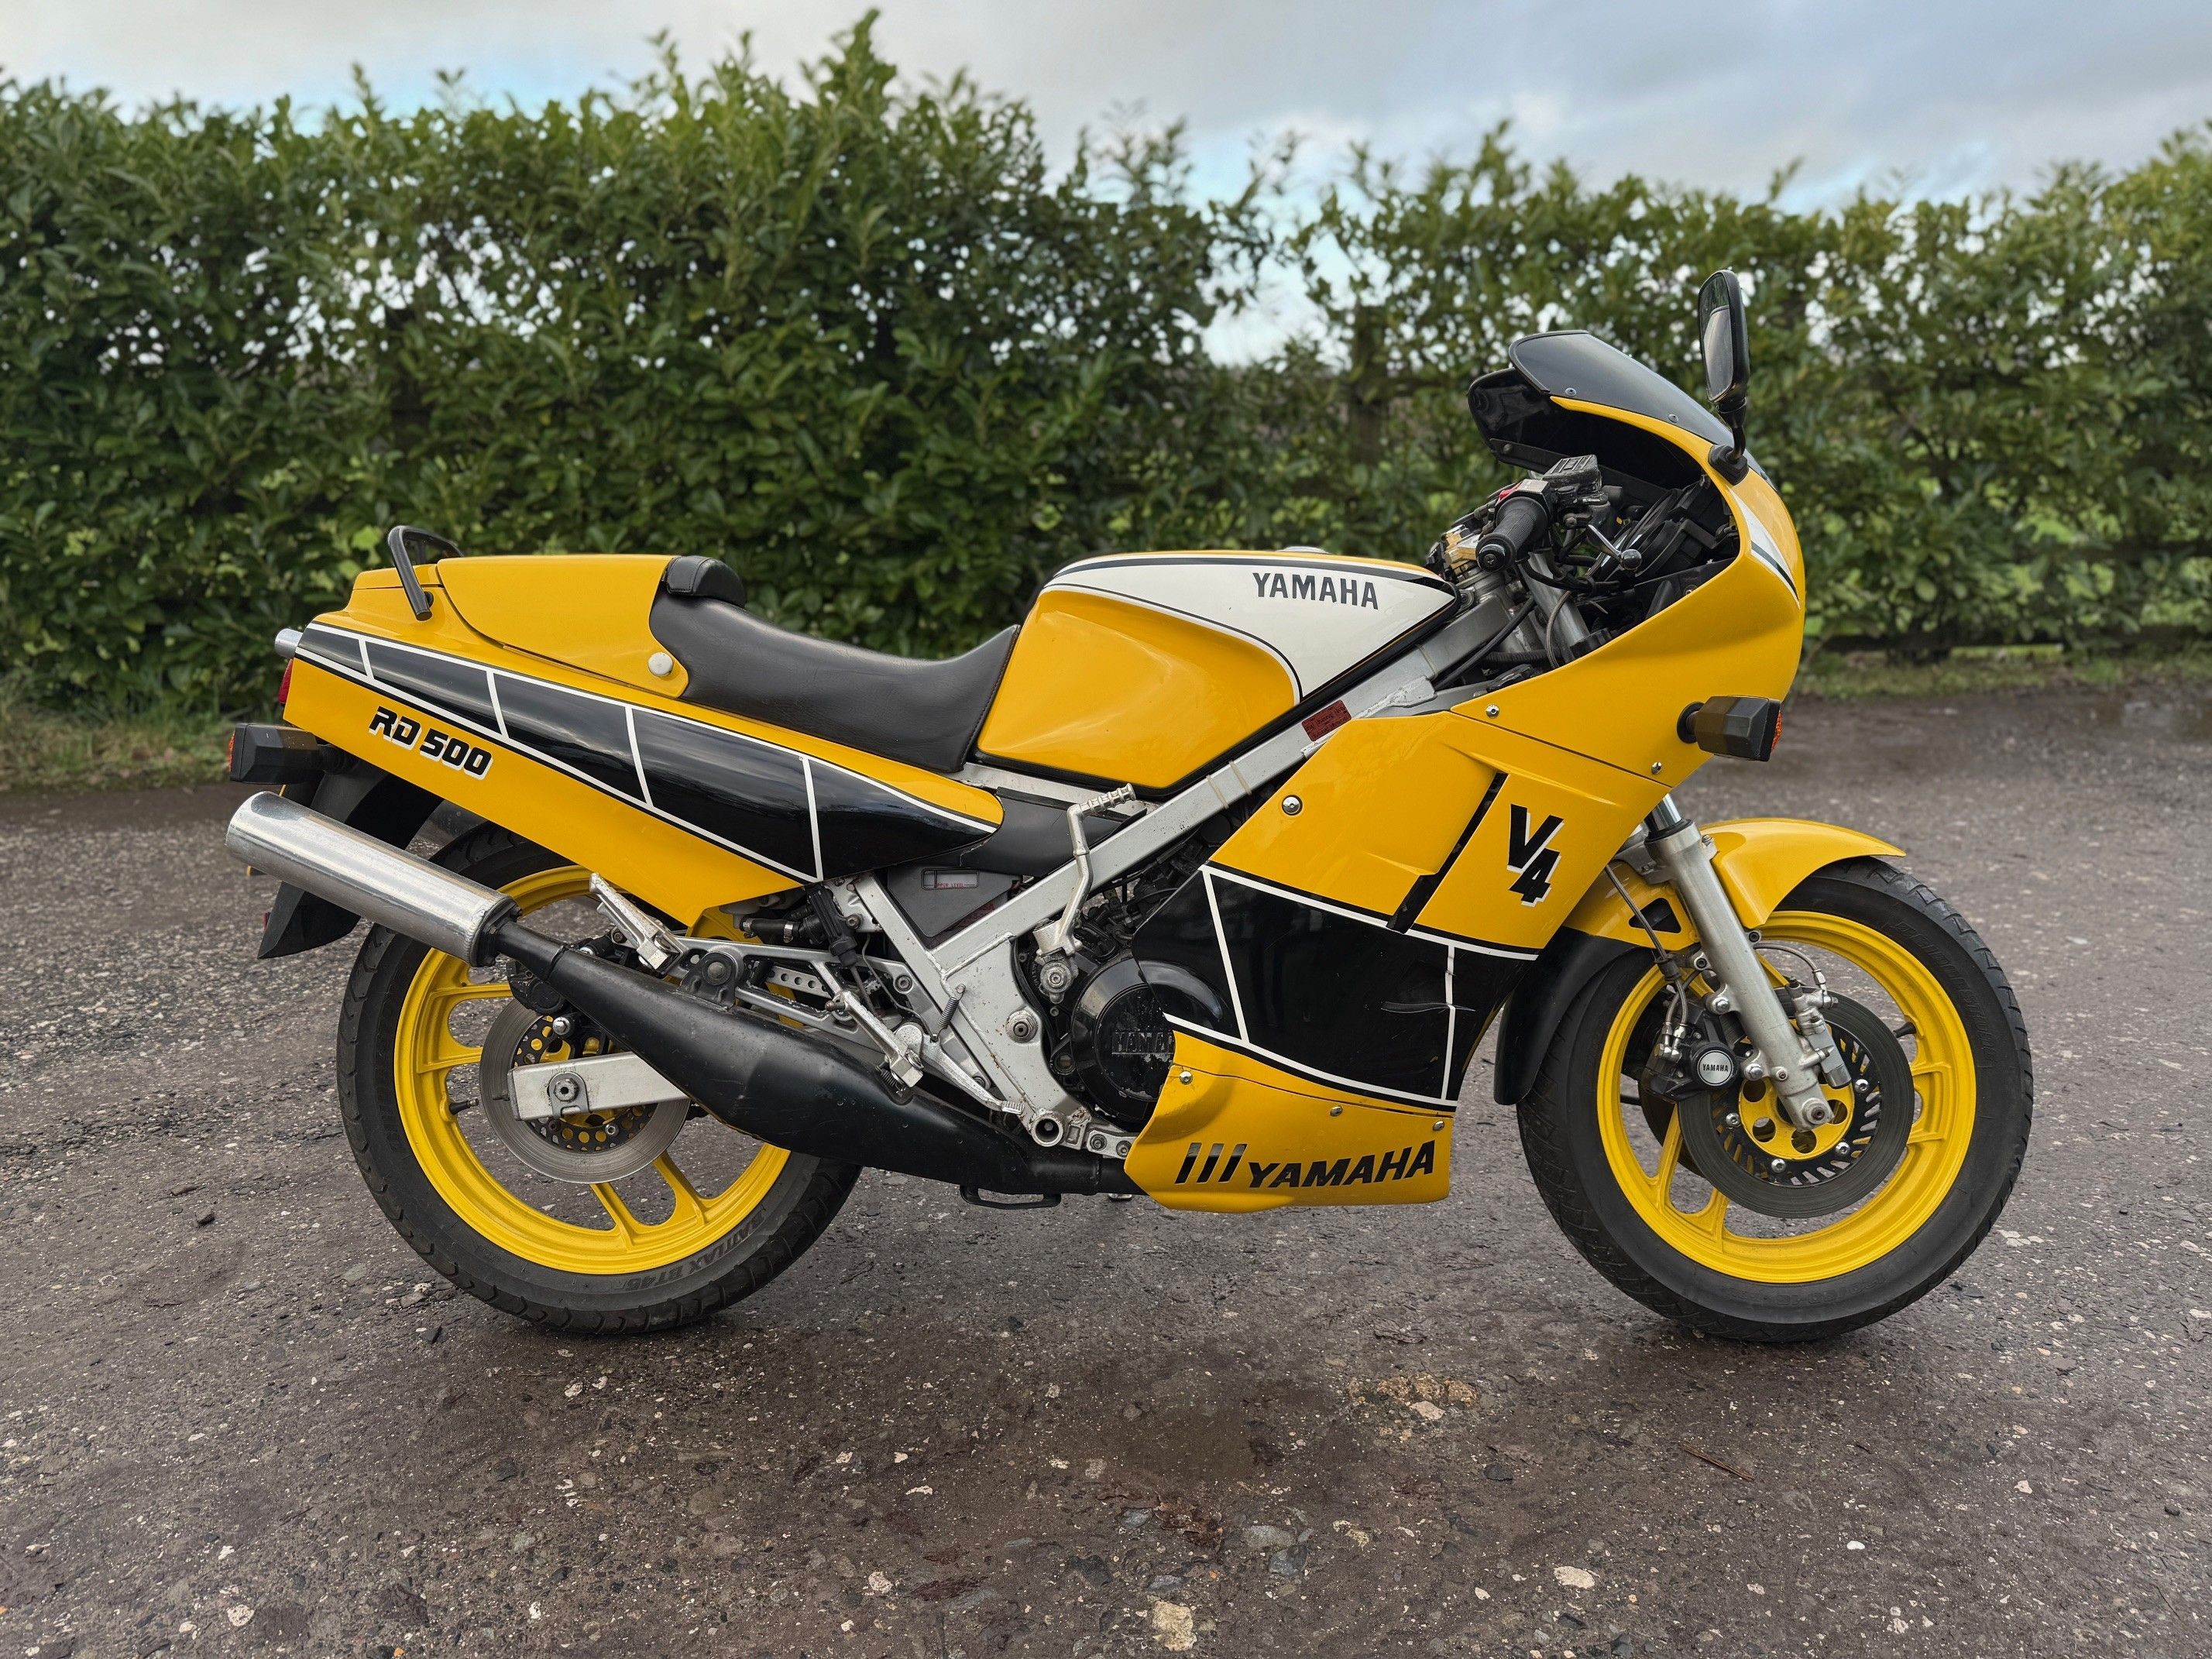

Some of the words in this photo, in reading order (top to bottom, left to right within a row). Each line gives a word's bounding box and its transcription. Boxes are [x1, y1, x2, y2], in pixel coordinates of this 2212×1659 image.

[1252, 572, 1379, 610] YAMAHA
[369, 706, 422, 750] RD
[419, 727, 493, 781] 500
[1702, 1063, 1729, 1072] YAMAHA
[1249, 1139, 1436, 1189] YAMAHA
